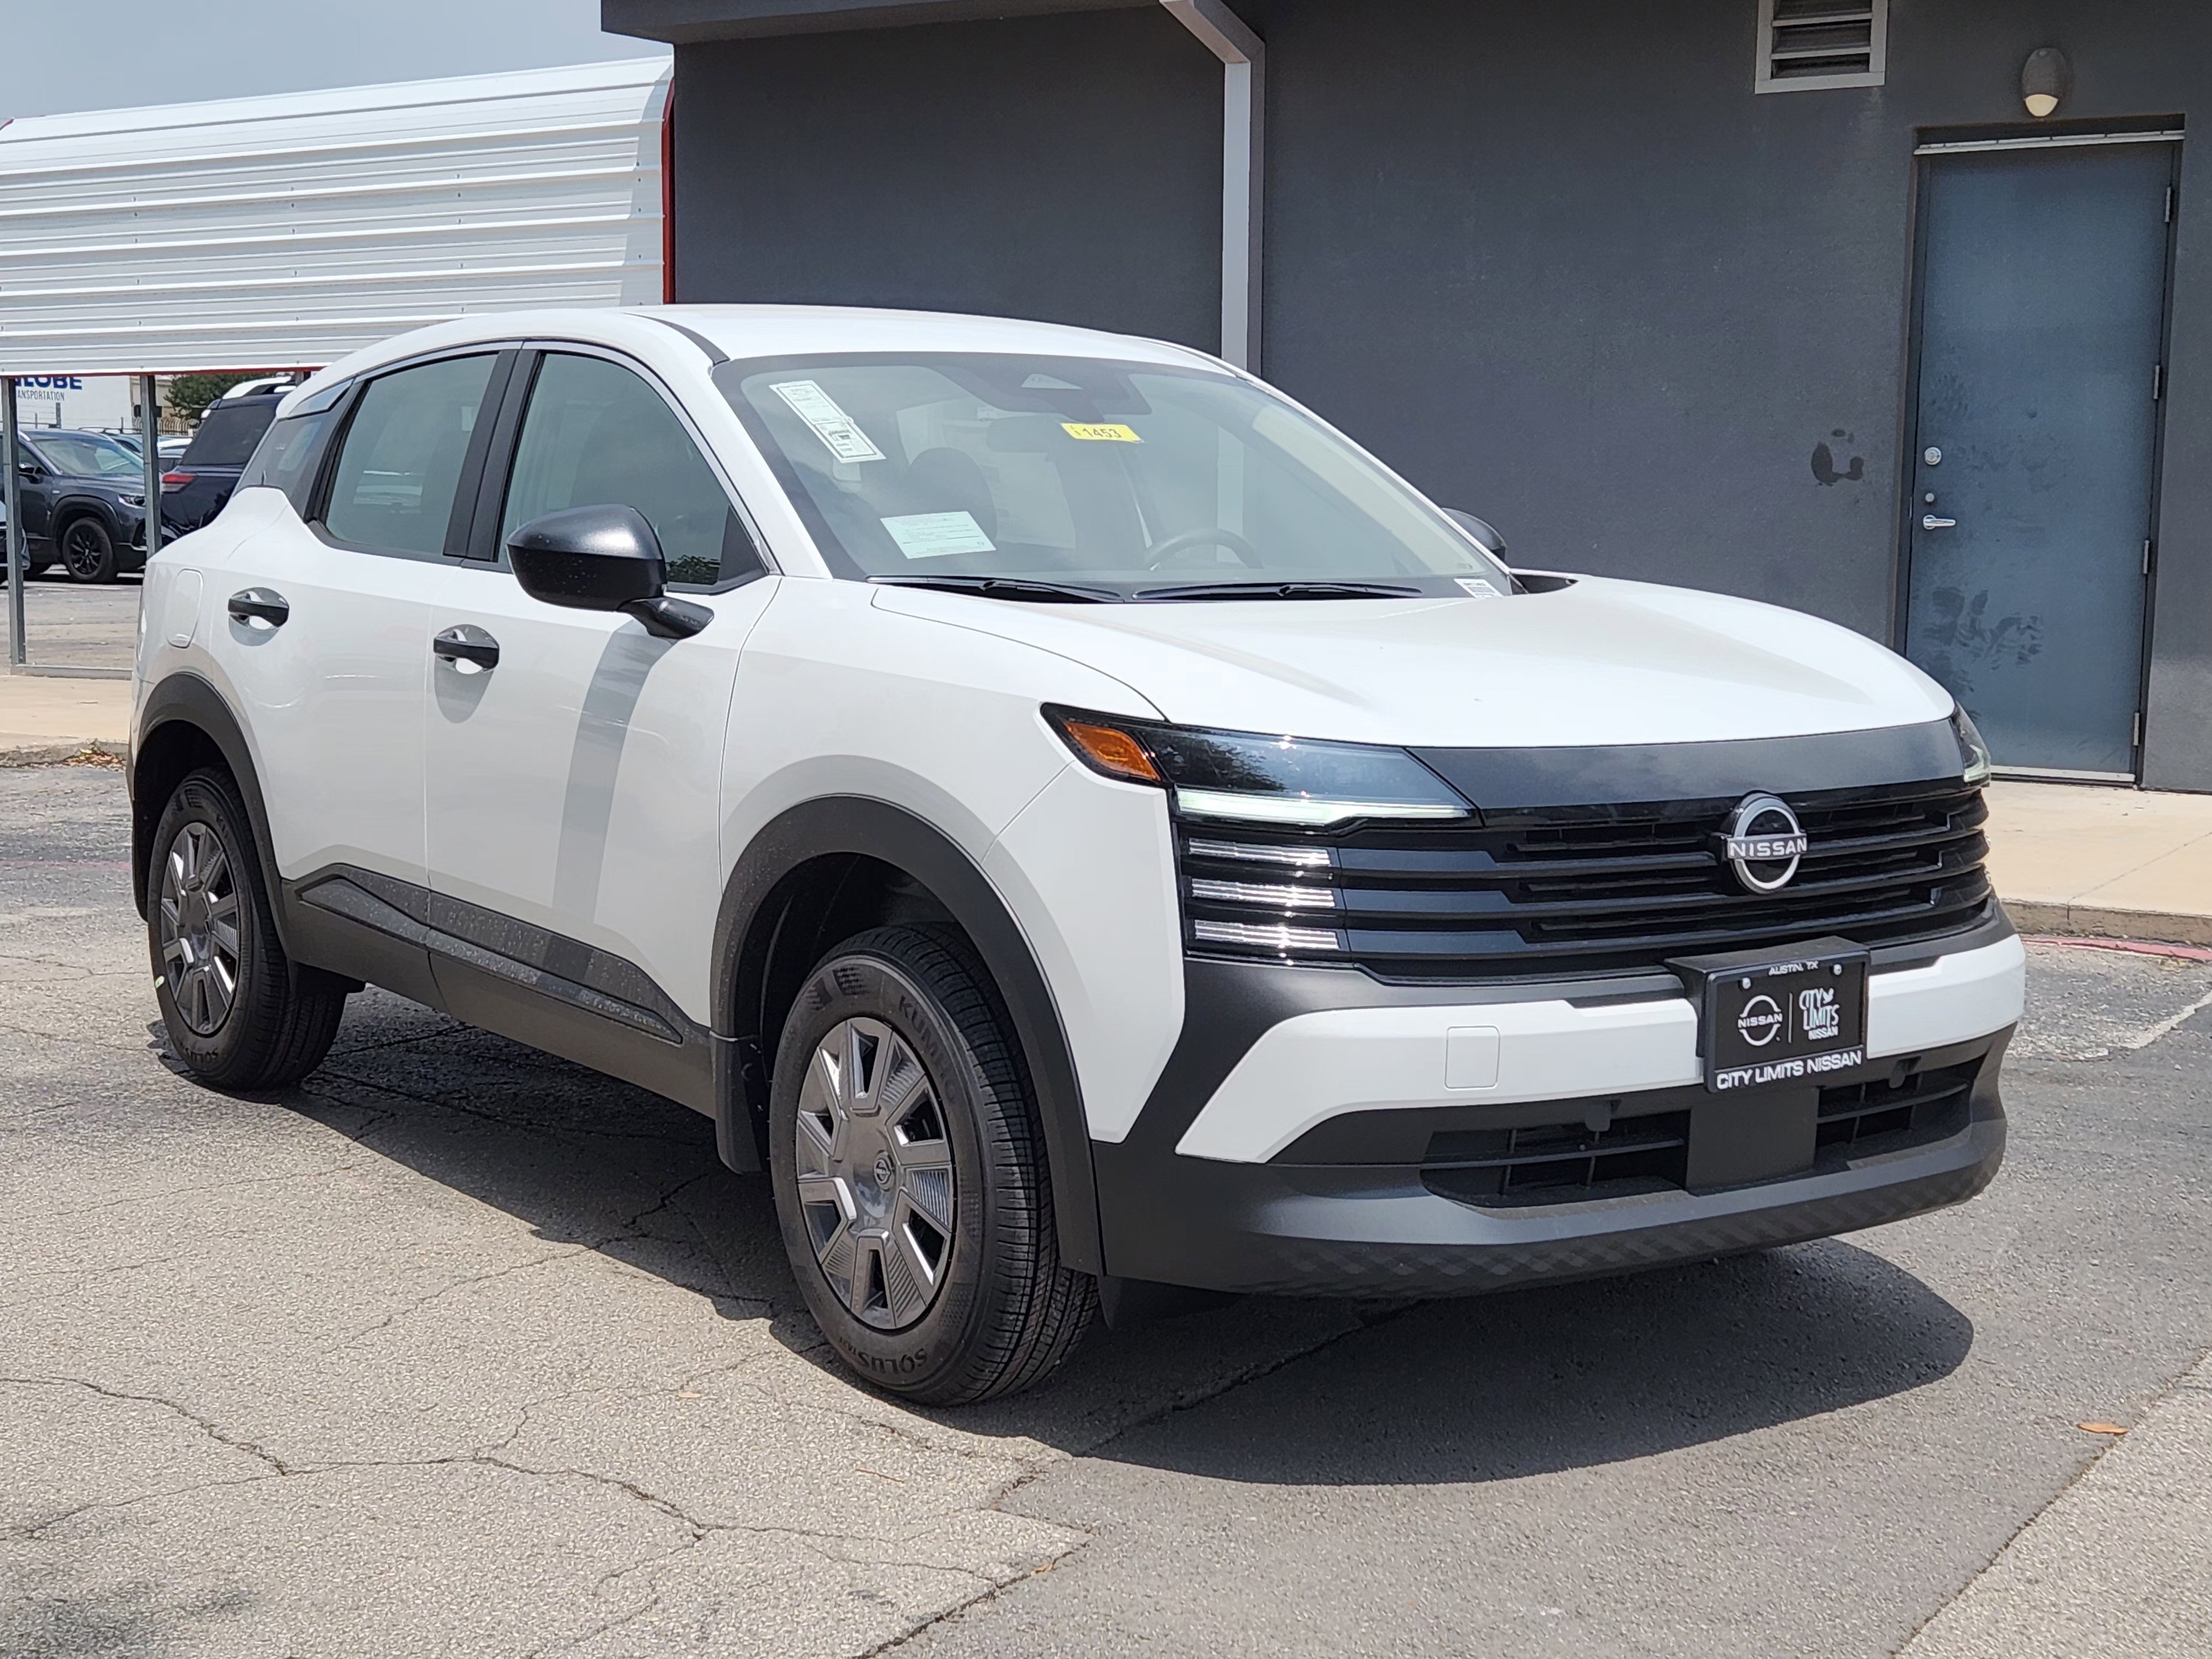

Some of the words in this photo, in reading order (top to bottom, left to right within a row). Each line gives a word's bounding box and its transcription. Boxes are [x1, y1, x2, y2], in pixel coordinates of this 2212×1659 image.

[15, 377, 82, 390] LOBE
[18, 389, 65, 401] ANSPORTATION
[1082, 427, 1122, 438] 1453
[1729, 837, 1807, 857] NISSAN
[1804, 961, 1819, 970] TX
[1799, 988, 1825, 1010] CITY
[1738, 1013, 1783, 1029] NISSAN
[1803, 1004, 1840, 1030] LIMITS
[1808, 1026, 1839, 1040] NISSAN
[1717, 1068, 1753, 1089] CITY
[1755, 1060, 1804, 1083] LIMITS
[1806, 1050, 1862, 1074] NISSAN
[858, 1348, 928, 1375] SOLUS
